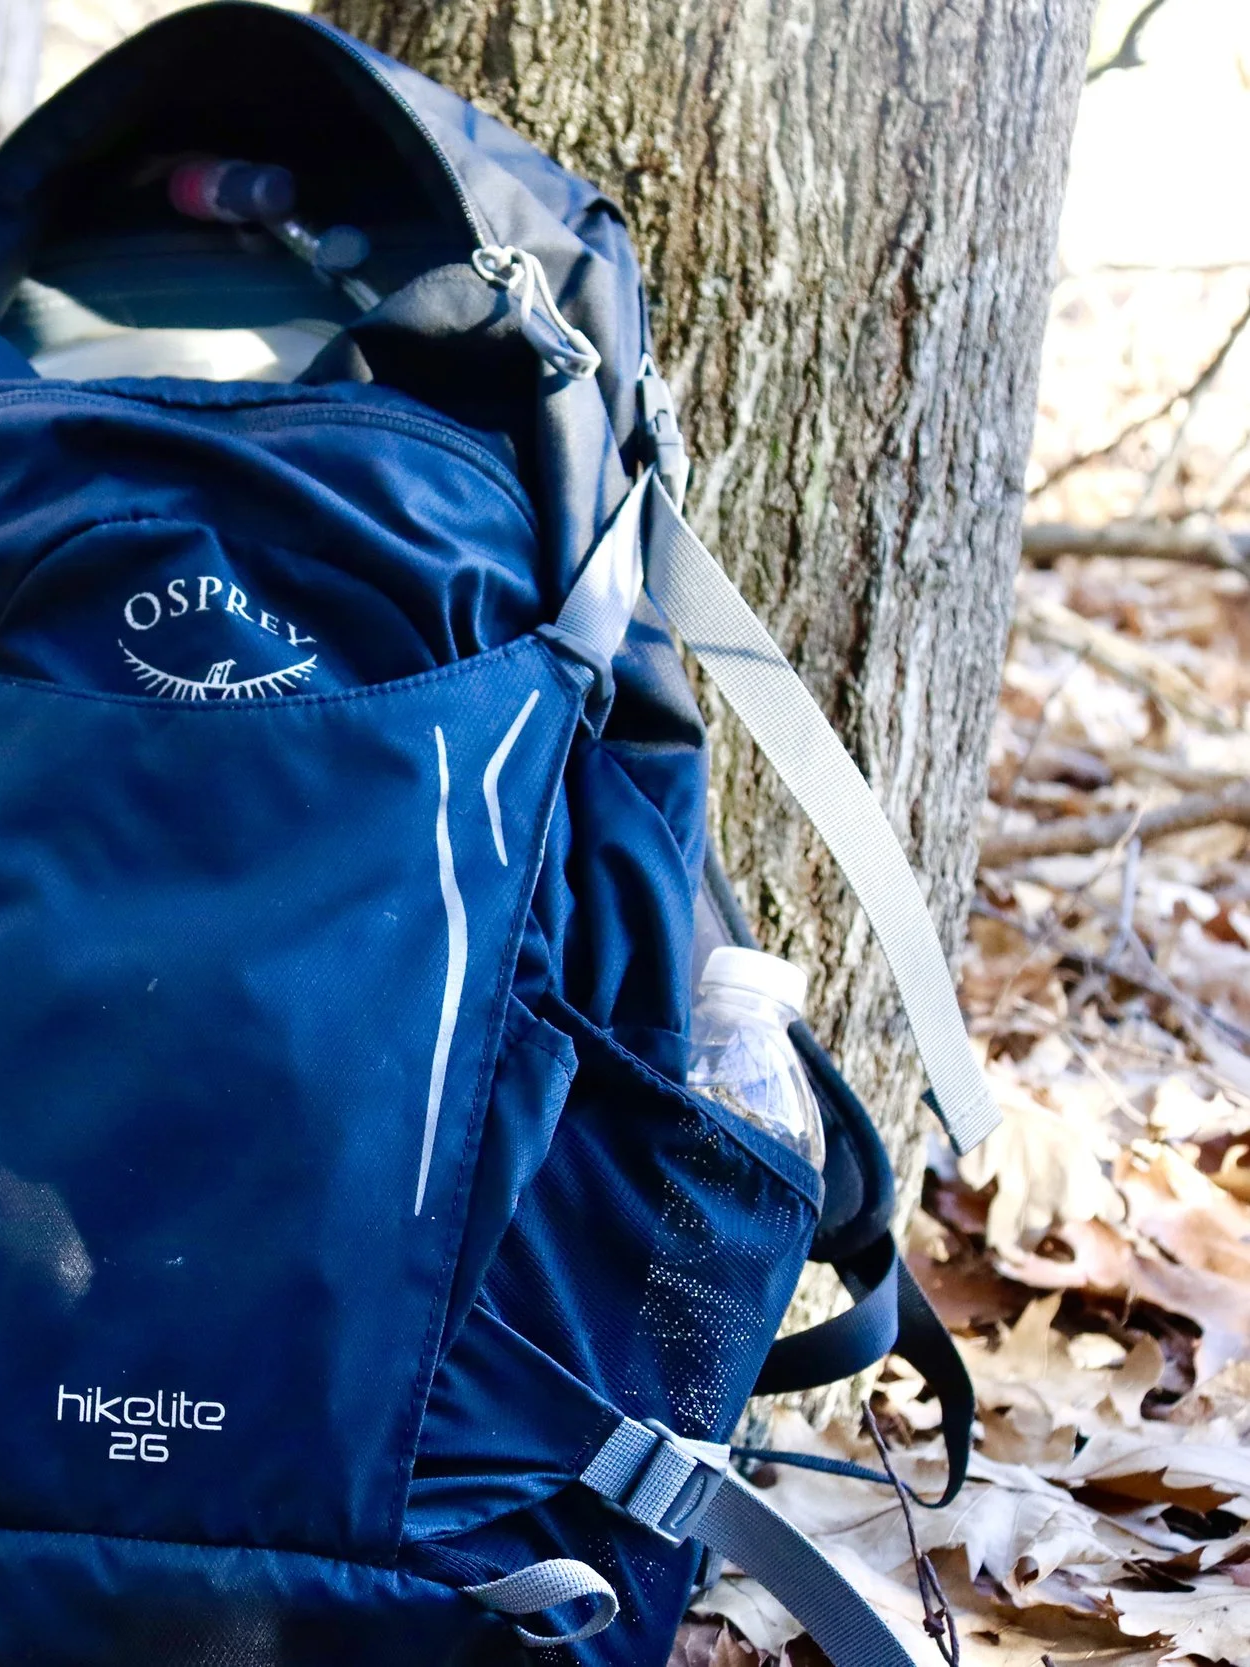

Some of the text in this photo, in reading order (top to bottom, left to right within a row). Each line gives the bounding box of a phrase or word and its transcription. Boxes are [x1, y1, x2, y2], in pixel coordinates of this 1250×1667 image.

[124, 576, 317, 647] OSPREY
[57, 1384, 226, 1430] hikelite
[108, 1431, 170, 1463] 26
